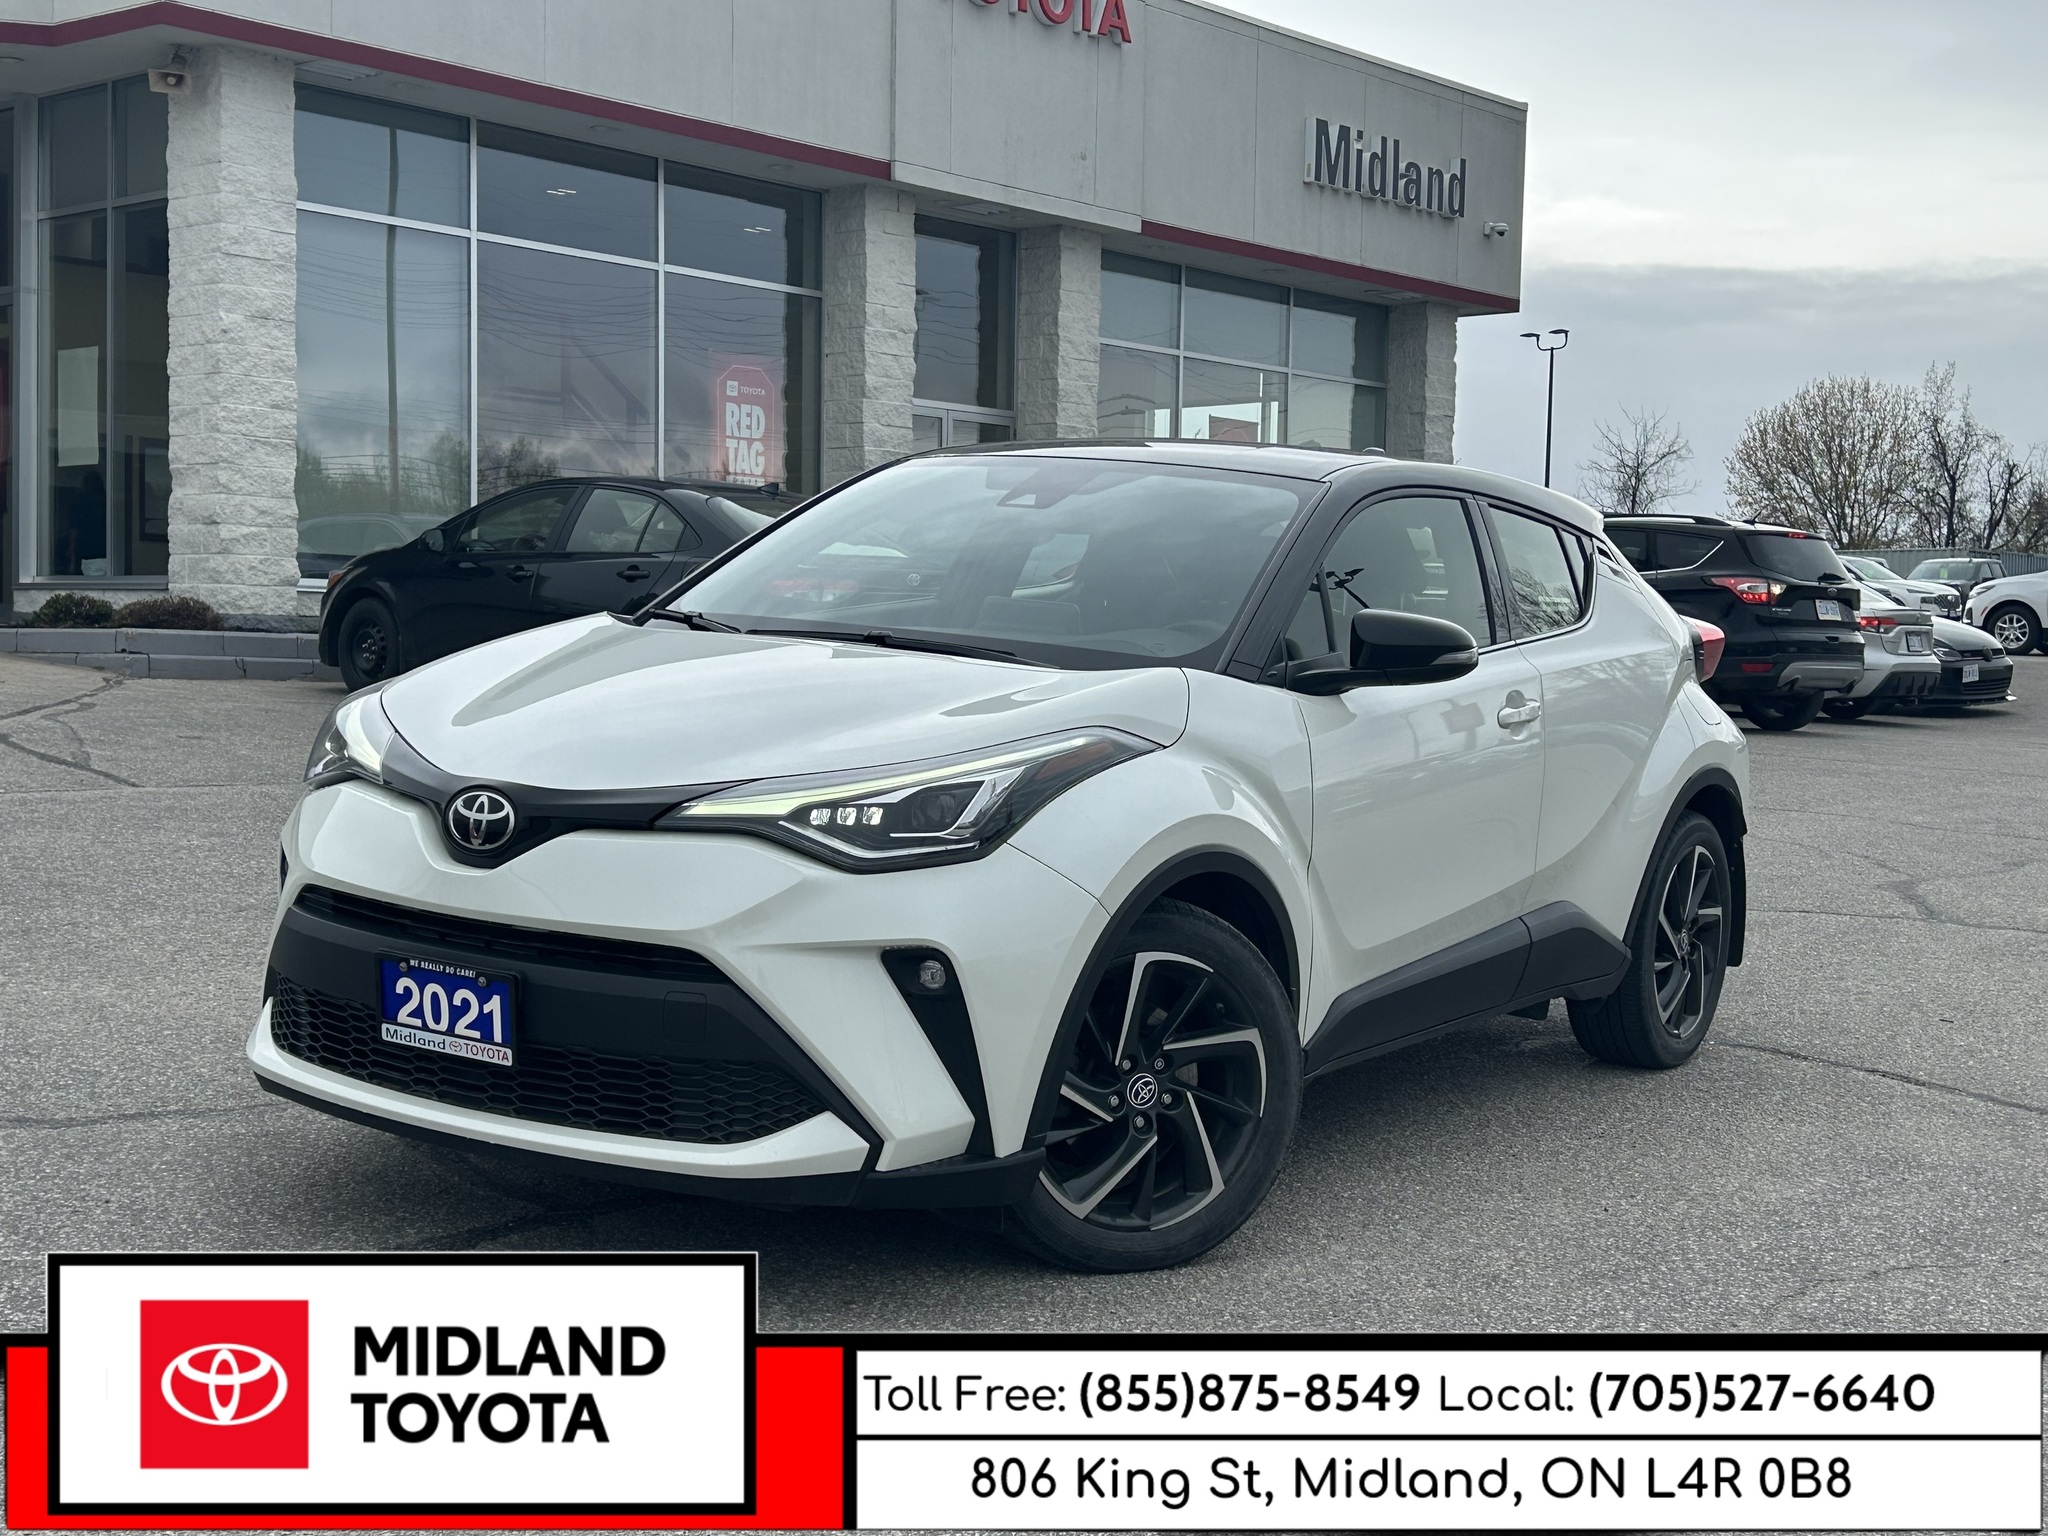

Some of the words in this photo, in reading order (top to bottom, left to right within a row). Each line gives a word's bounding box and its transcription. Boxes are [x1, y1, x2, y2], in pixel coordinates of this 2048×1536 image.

[1311, 118, 1467, 218] Midland
[740, 386, 766, 396] TOYOTA
[725, 402, 766, 439] RED
[725, 438, 766, 475] TAG
[409, 959, 419, 967] WE
[420, 961, 444, 972] REALLY
[445, 966, 455, 974] DO
[456, 968, 476, 978] CARE!
[395, 976, 503, 1044] 2021
[385, 1027, 446, 1050] Midland
[463, 1042, 510, 1063] TOYOTA
